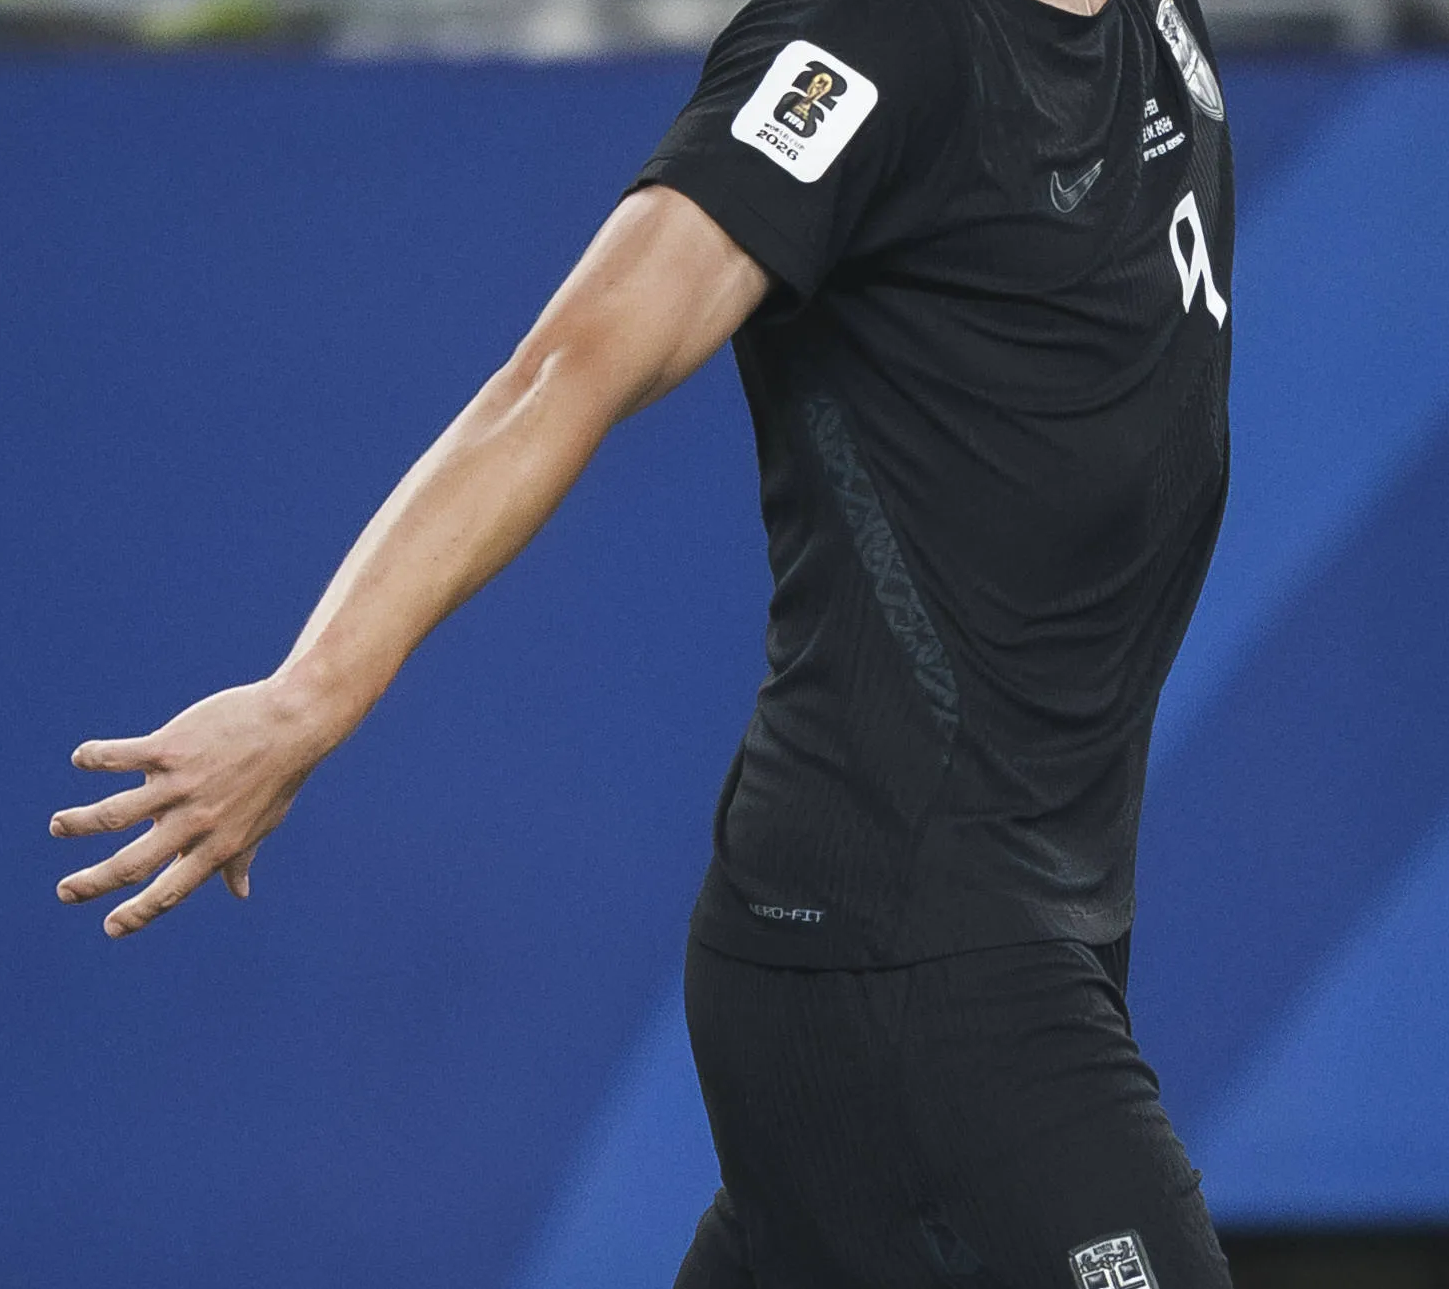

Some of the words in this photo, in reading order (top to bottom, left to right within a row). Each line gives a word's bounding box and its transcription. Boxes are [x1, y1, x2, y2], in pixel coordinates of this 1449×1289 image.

[783, 111, 806, 132] FIFA
[755, 129, 799, 161] 2026
[1168, 189, 1228, 332] 9
